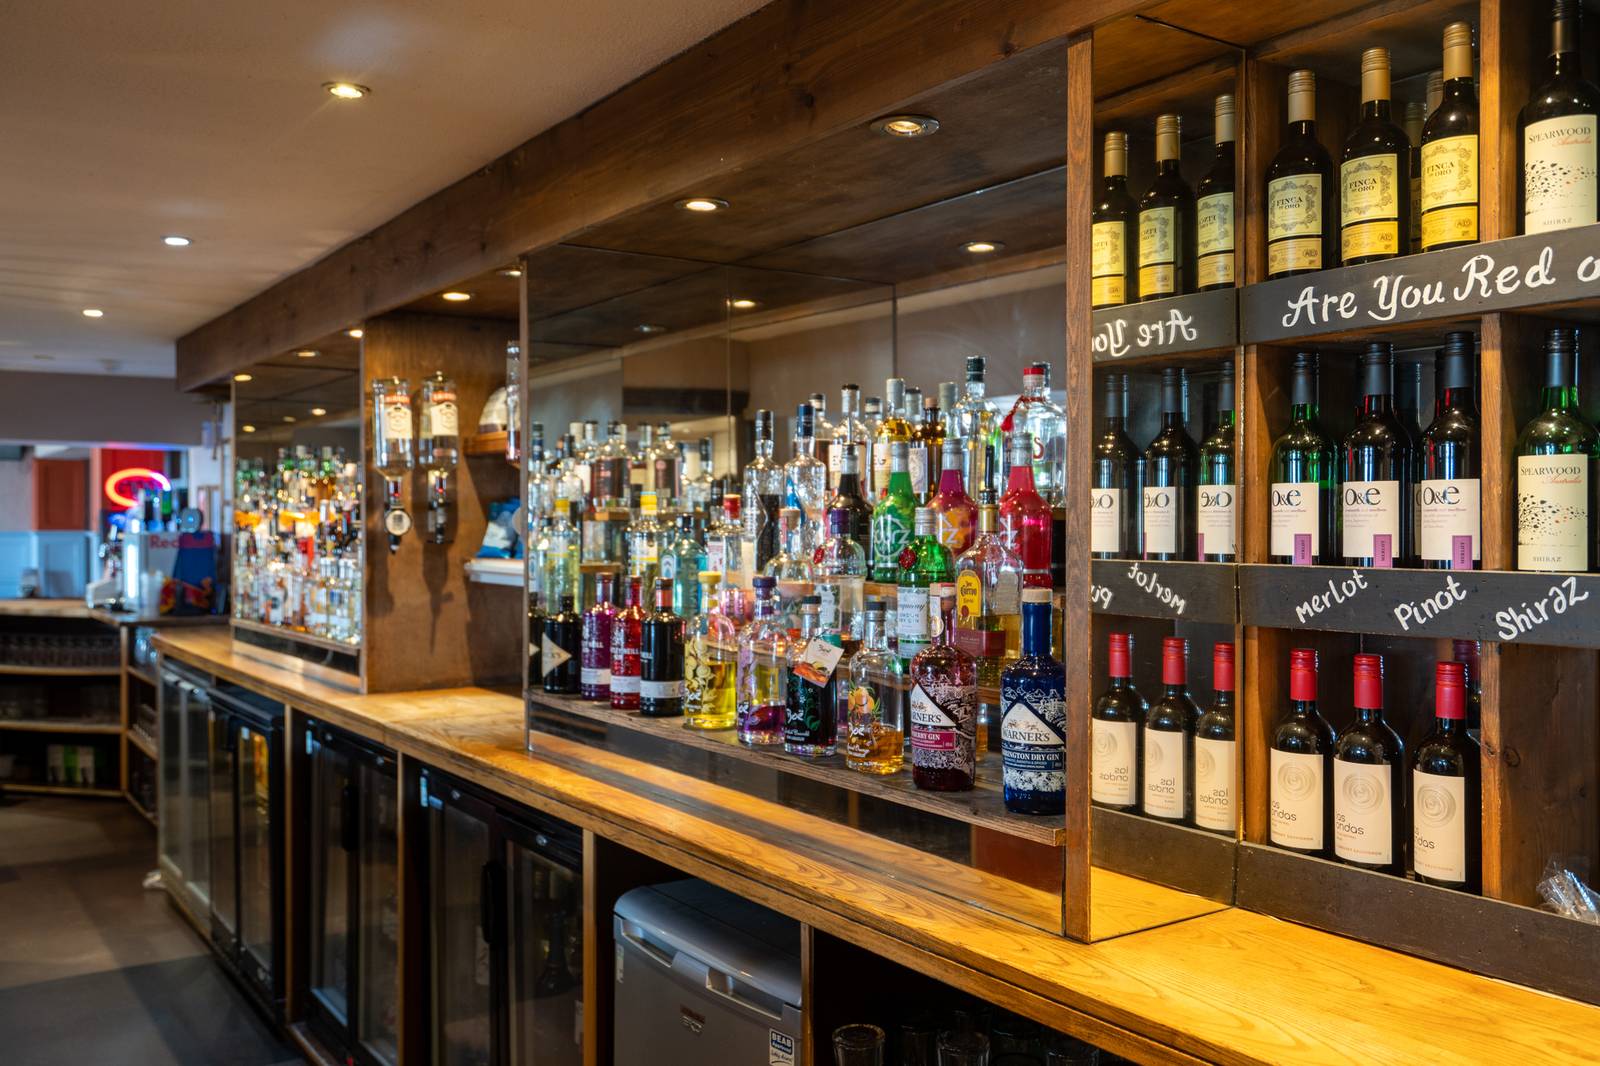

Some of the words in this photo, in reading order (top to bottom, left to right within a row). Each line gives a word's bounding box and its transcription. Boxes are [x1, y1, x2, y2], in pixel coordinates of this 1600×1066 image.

[1528, 127, 1591, 143] SPEARWOOD
[1426, 161, 1455, 173] FINCA
[1349, 178, 1377, 189] FINCA
[1358, 185, 1375, 193] ORO
[1276, 196, 1303, 207] FINCA
[1282, 286, 1358, 328] Are
[1368, 274, 1445, 320] You
[1454, 246, 1555, 301] Red
[1577, 255, 1600, 282] o
[1520, 465, 1581, 476] SPEARWOOD
[1272, 489, 1301, 507] O&e
[1345, 488, 1381, 506] O&e
[1423, 486, 1460, 505] O&e
[1394, 575, 1467, 631] Pinot
[1496, 576, 1589, 641] Shiraz
[912, 711, 942, 723] RNER'S
[928, 733, 940, 741] GIN
[1030, 753, 1047, 761] DRY
[1047, 753, 1060, 761] GIN
